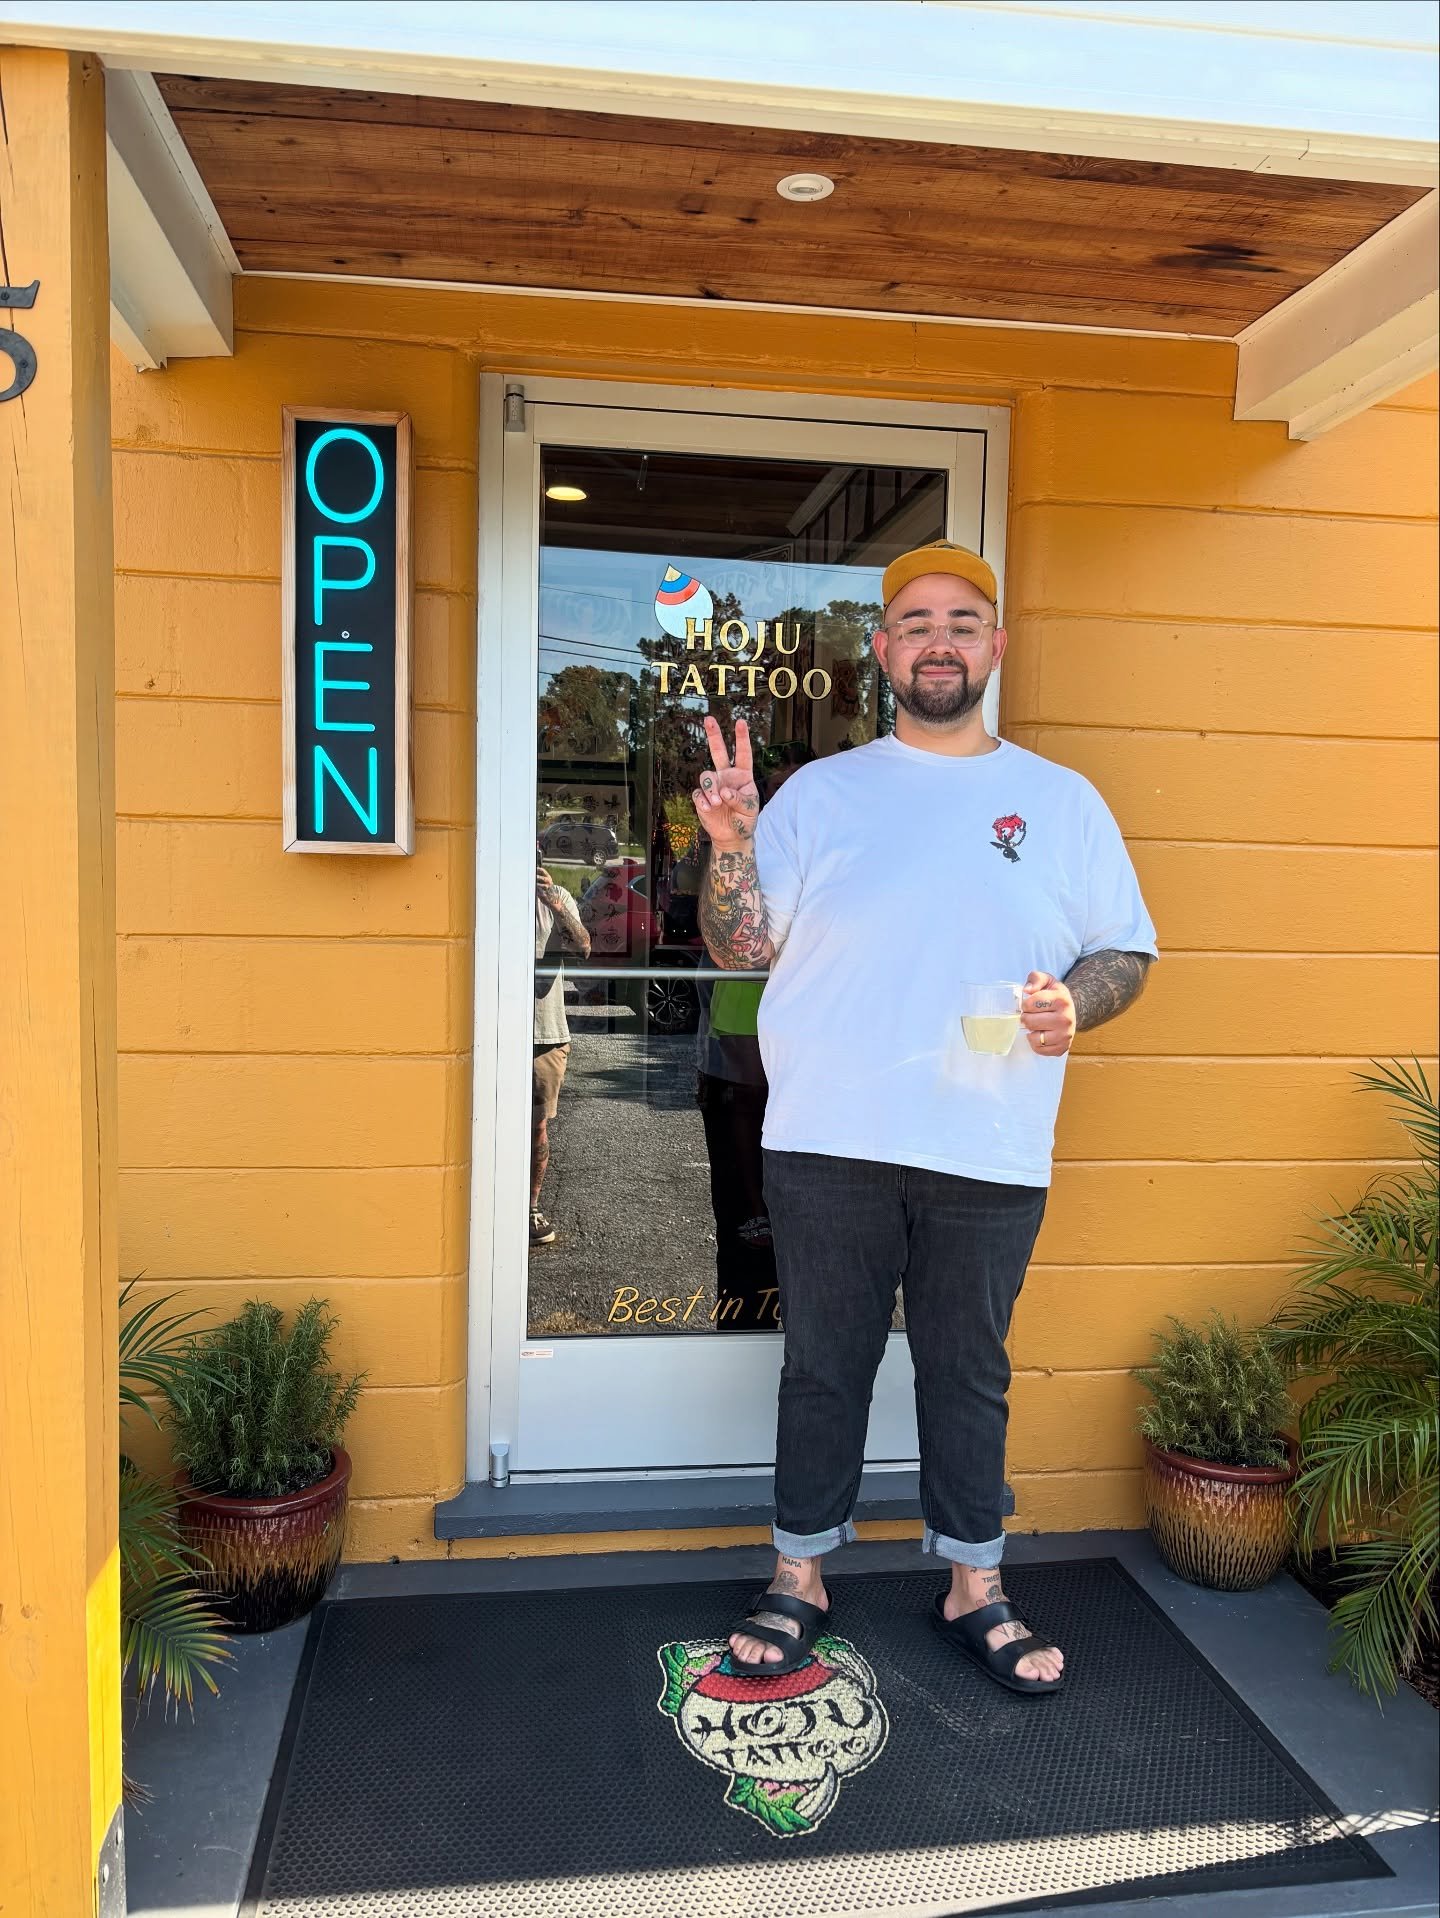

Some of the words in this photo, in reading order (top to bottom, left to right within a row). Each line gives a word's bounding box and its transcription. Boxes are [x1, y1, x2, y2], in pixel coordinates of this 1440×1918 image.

[305, 428, 384, 835] OPEN
[685, 617, 801, 662] HOJU
[651, 661, 832, 700] TATTOO
[607, 1285, 706, 1324] Best
[709, 1288, 744, 1321] in
[782, 1556, 802, 1568] MAMA
[691, 1699, 873, 1748] HOJU
[712, 1736, 869, 1767] TATTOO
